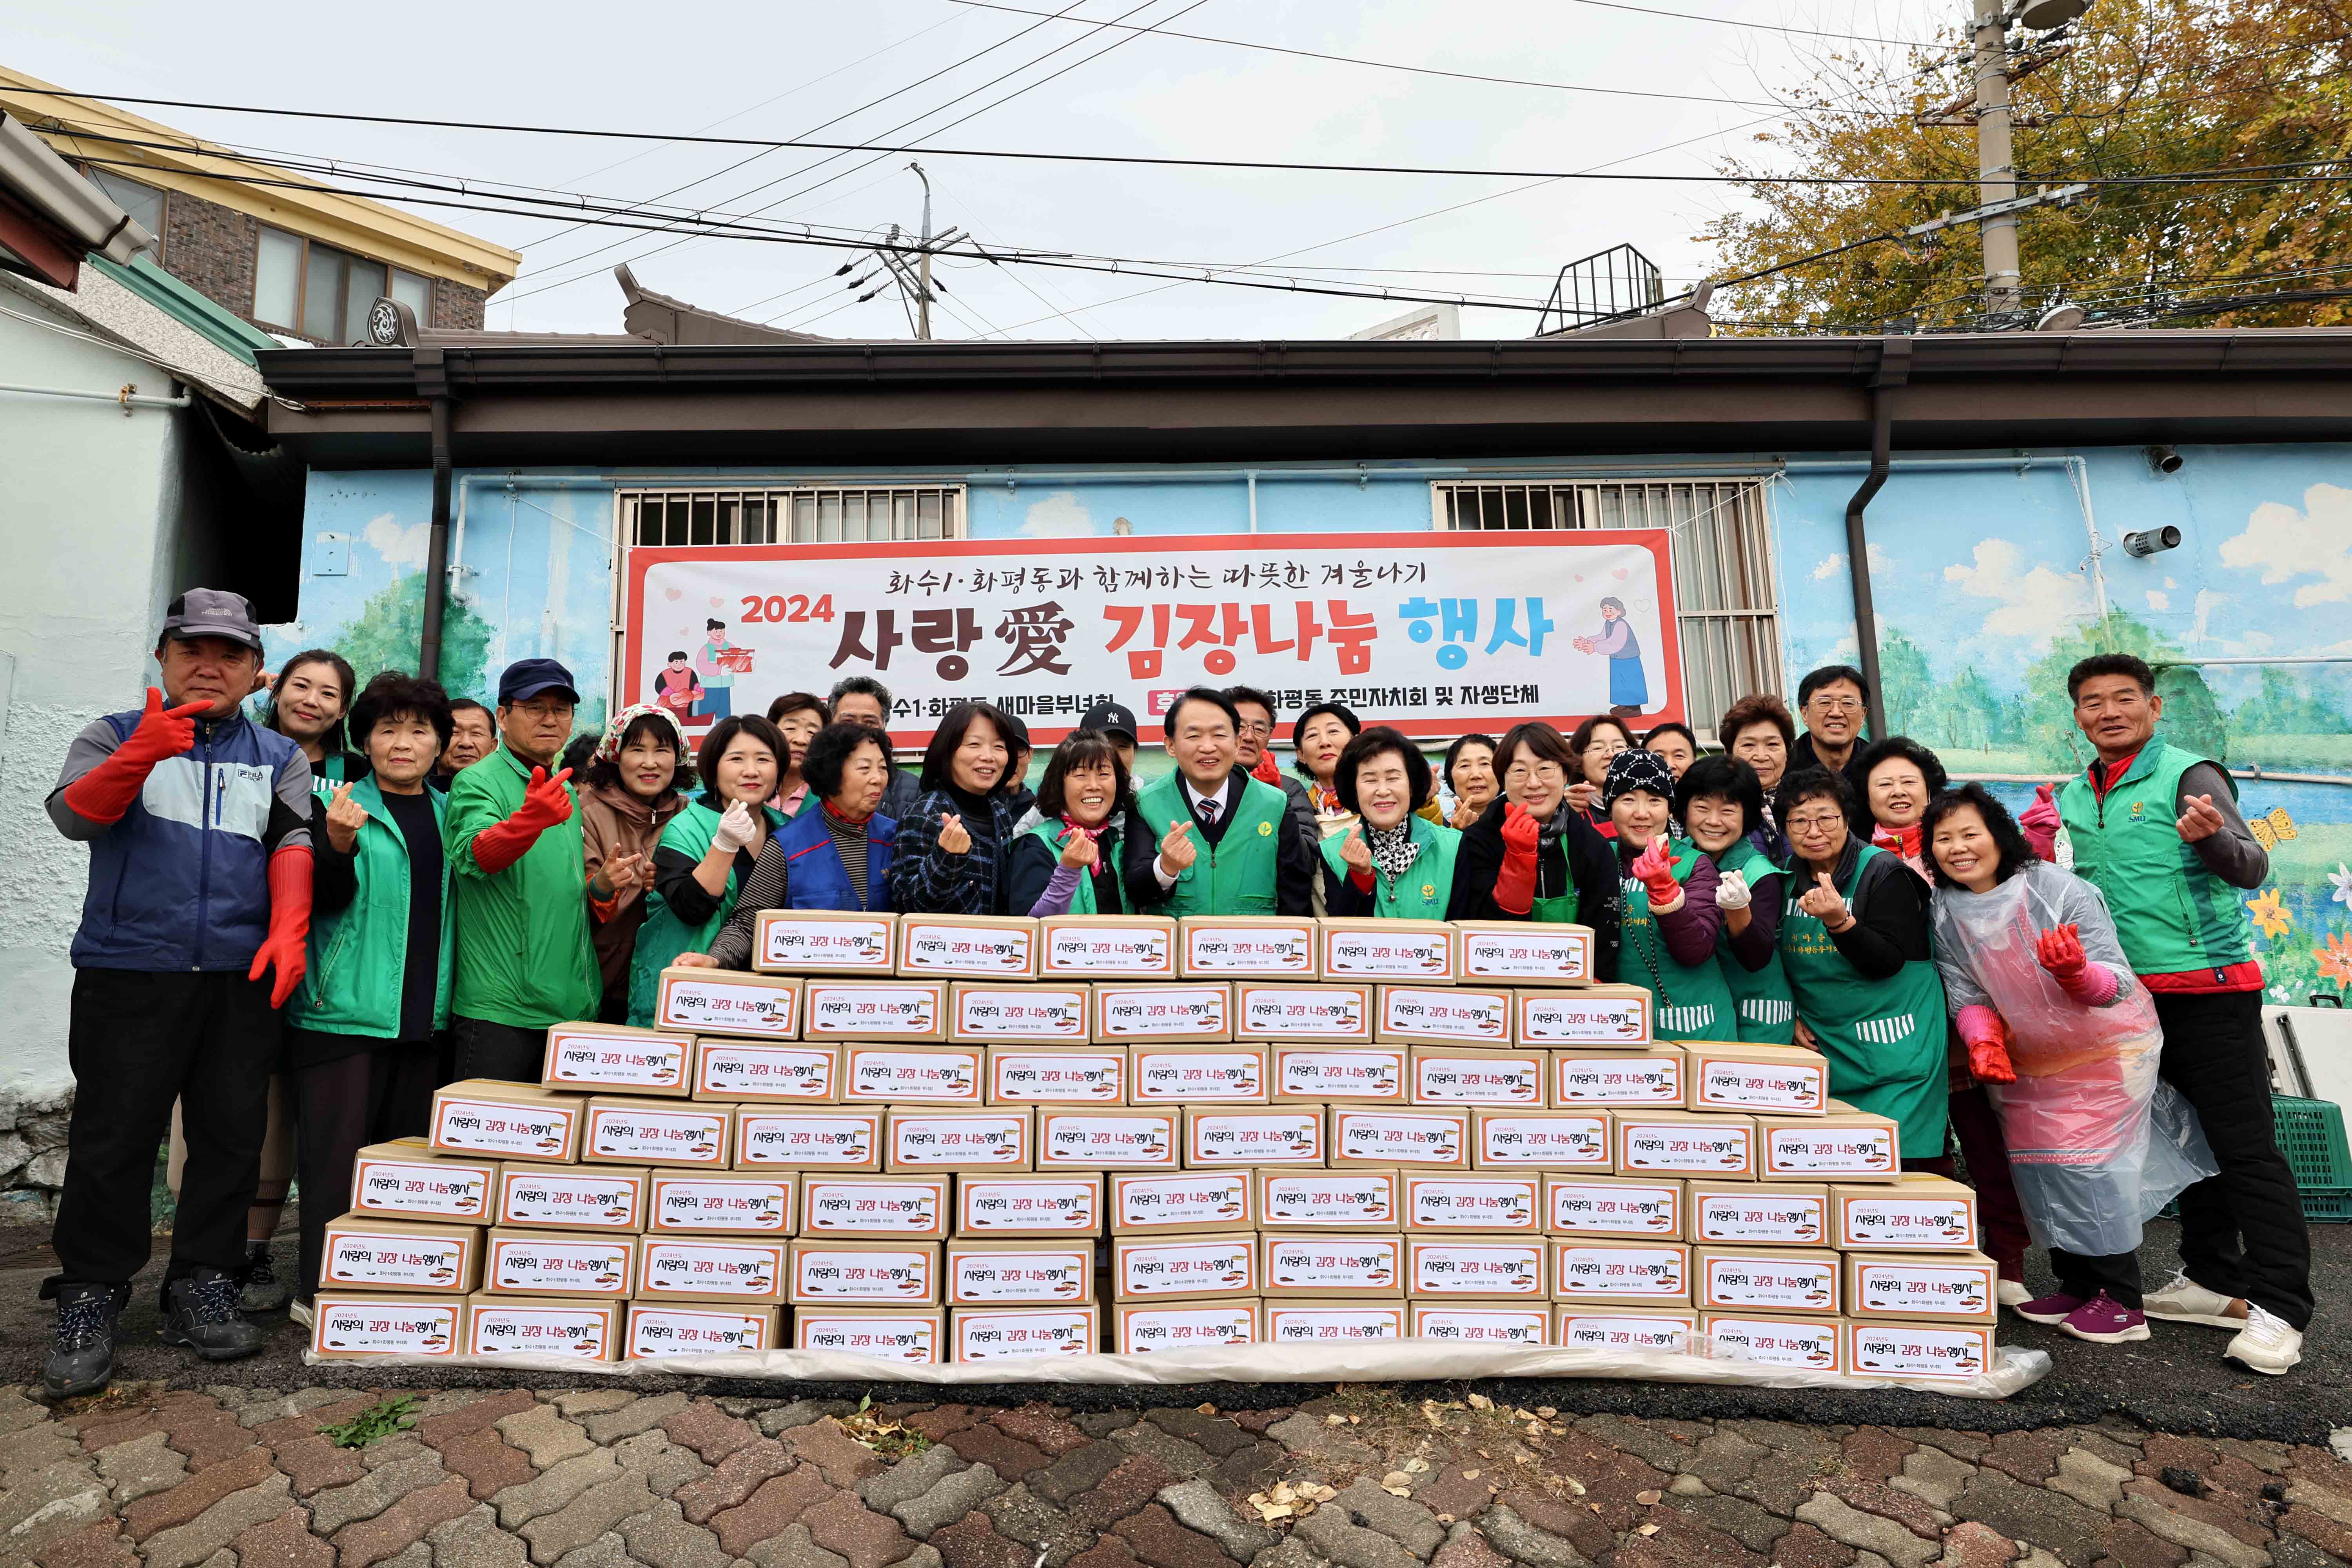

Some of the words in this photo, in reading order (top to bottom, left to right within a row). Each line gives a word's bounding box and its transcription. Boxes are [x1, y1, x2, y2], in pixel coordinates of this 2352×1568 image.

[886, 567, 1083, 596] 화수1·화평동과
[1093, 565, 1213, 593] 함께하는
[1223, 561, 1310, 589] 따뜻한
[1322, 561, 1426, 588] 겨울나기
[741, 594, 835, 622] 2024
[1103, 600, 1378, 680] 김장나눔
[1399, 597, 1554, 670] 행사
[1330, 687, 1427, 708] 주민자치회
[1435, 686, 1453, 706] 및
[1461, 684, 1539, 705] 자생단체
[775, 935, 804, 946] 사랑의
[809, 936, 829, 946] 김장
[1475, 947, 1503, 958] 사랑의
[1508, 949, 1528, 959] 김장
[821, 1003, 851, 1013] 사랑의
[856, 1003, 876, 1014] 김장
[1112, 1006, 1142, 1016] 사랑의
[1146, 1005, 1166, 1016] 김장
[1533, 1013, 1562, 1024] 사랑의
[1567, 1014, 1586, 1024] 김장
[564, 1051, 595, 1063] 사랑의
[601, 1053, 622, 1064] 김장
[1148, 1069, 1177, 1080] 사랑의
[1183, 1070, 1202, 1080] 김장
[1711, 1076, 1740, 1087] 사랑의
[1745, 1078, 1764, 1089] 김장
[448, 1116, 480, 1129] 사랑의
[485, 1120, 506, 1132] 김장
[904, 1134, 935, 1145] 사랑의
[940, 1134, 961, 1144] 김장
[1779, 1144, 1808, 1154] 사랑의
[1813, 1144, 1833, 1154] 김장
[515, 1191, 547, 1202] 사랑의
[552, 1192, 573, 1203] 김장
[976, 1199, 1006, 1210] 사랑의
[1012, 1199, 1033, 1210] 김장
[1562, 1200, 1591, 1211] 사랑의
[1596, 1201, 1616, 1212] 김장
[1855, 1215, 1885, 1226] 사랑의
[1890, 1216, 1910, 1226] 김장
[339, 1250, 371, 1262] 사랑의
[377, 1252, 398, 1264] 김장
[1133, 1262, 1163, 1274] 사랑의
[1169, 1261, 1189, 1273] 김장
[1870, 1280, 1901, 1292] 사랑의
[1906, 1281, 1927, 1293] 김장
[331, 1320, 363, 1331] 사랑의
[369, 1321, 390, 1332] 김장
[1864, 1343, 1895, 1355] 사랑의
[1901, 1345, 1922, 1356] 김장
